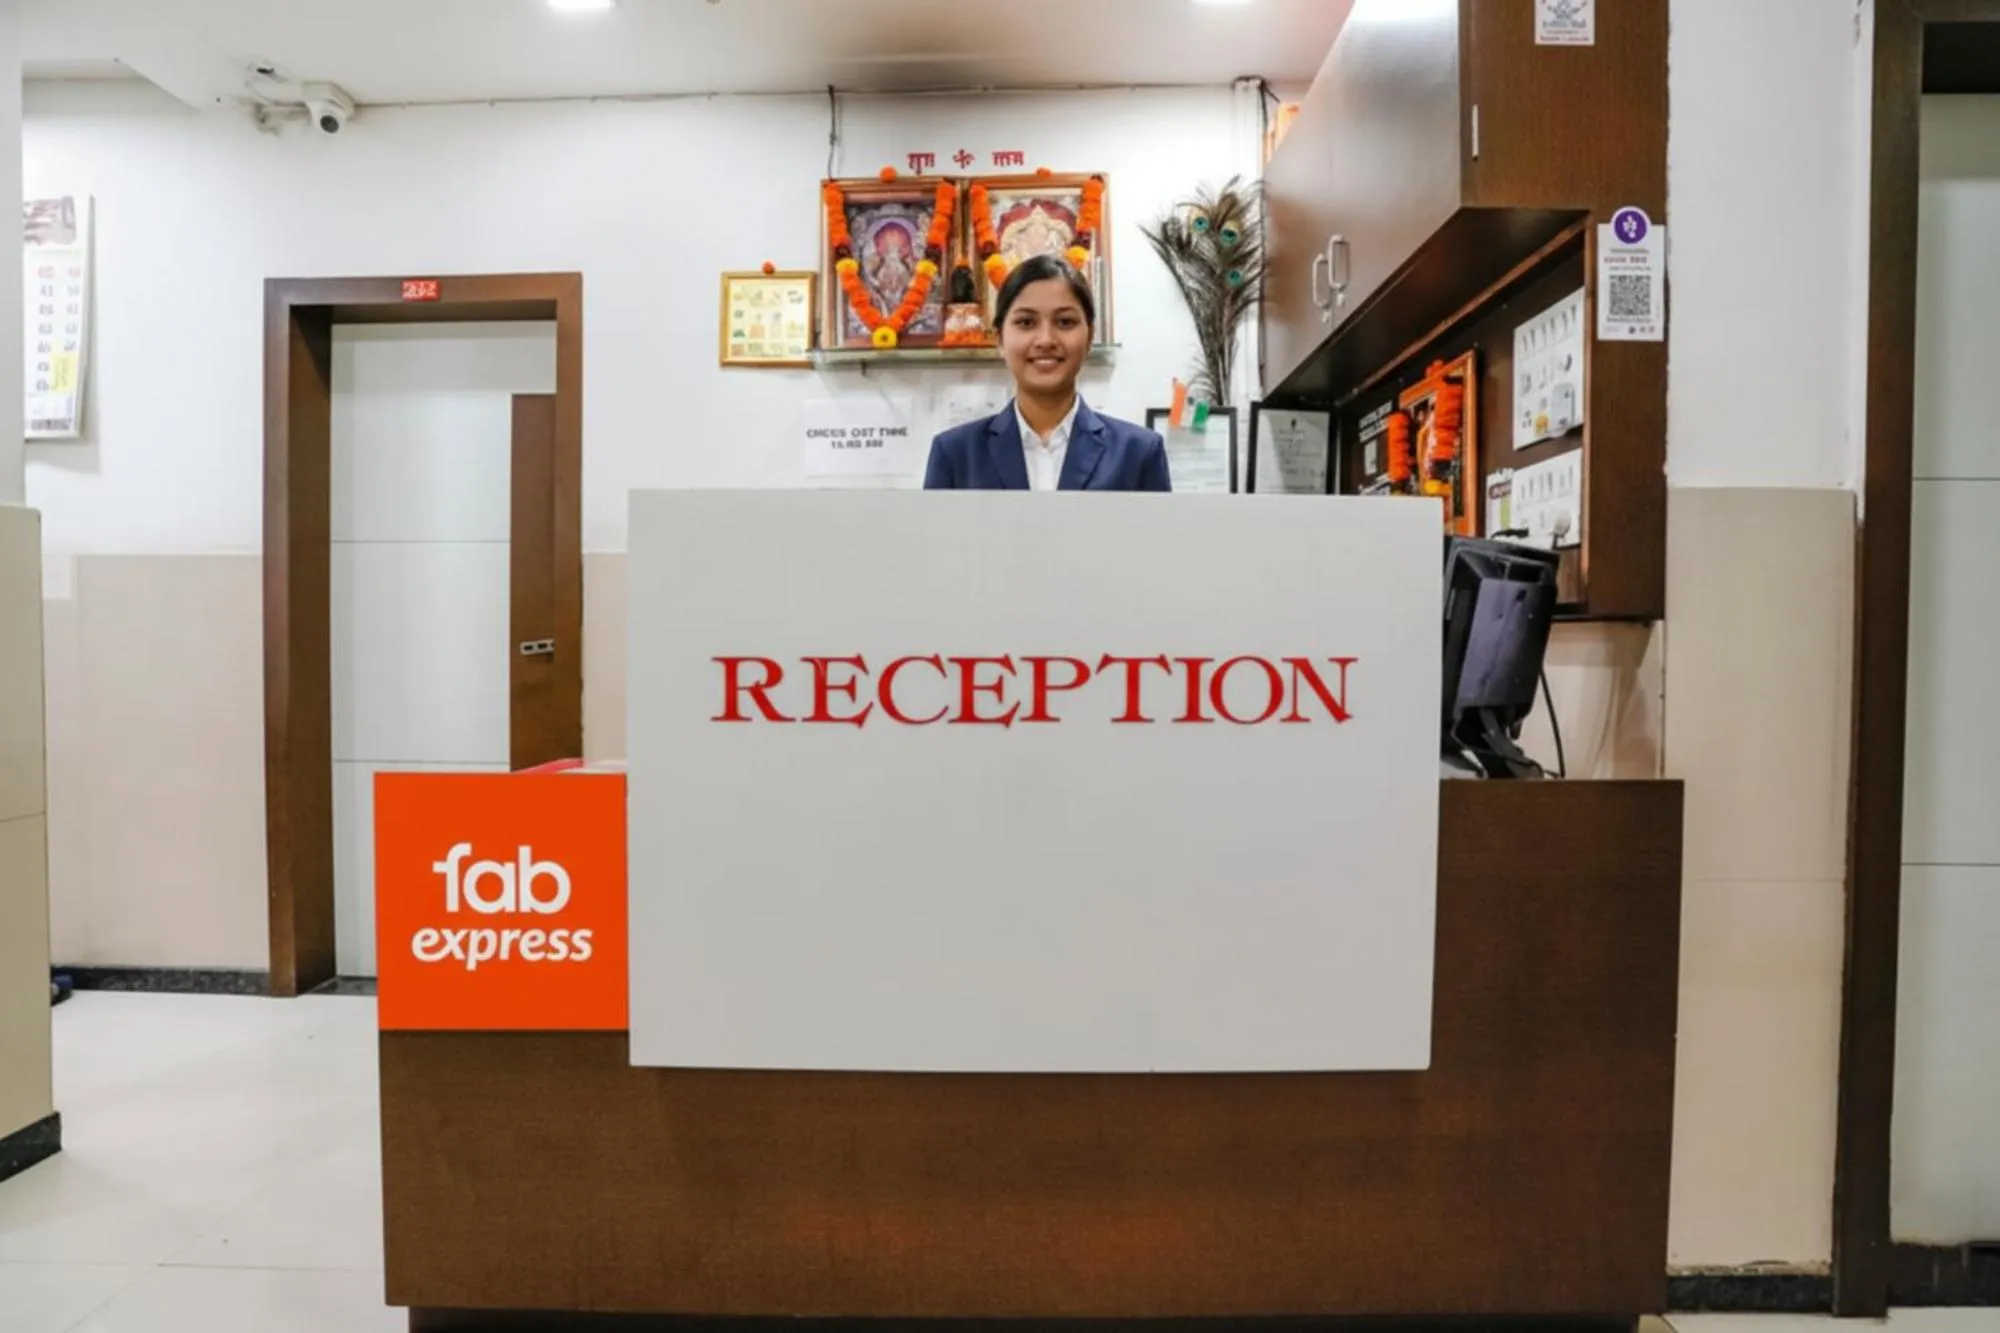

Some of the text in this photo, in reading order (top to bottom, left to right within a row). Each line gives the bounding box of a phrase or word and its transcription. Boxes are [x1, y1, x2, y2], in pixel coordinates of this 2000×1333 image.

[710, 653, 1359, 729] RECEPTION
[432, 842, 572, 915] fab
[411, 926, 593, 972] express
